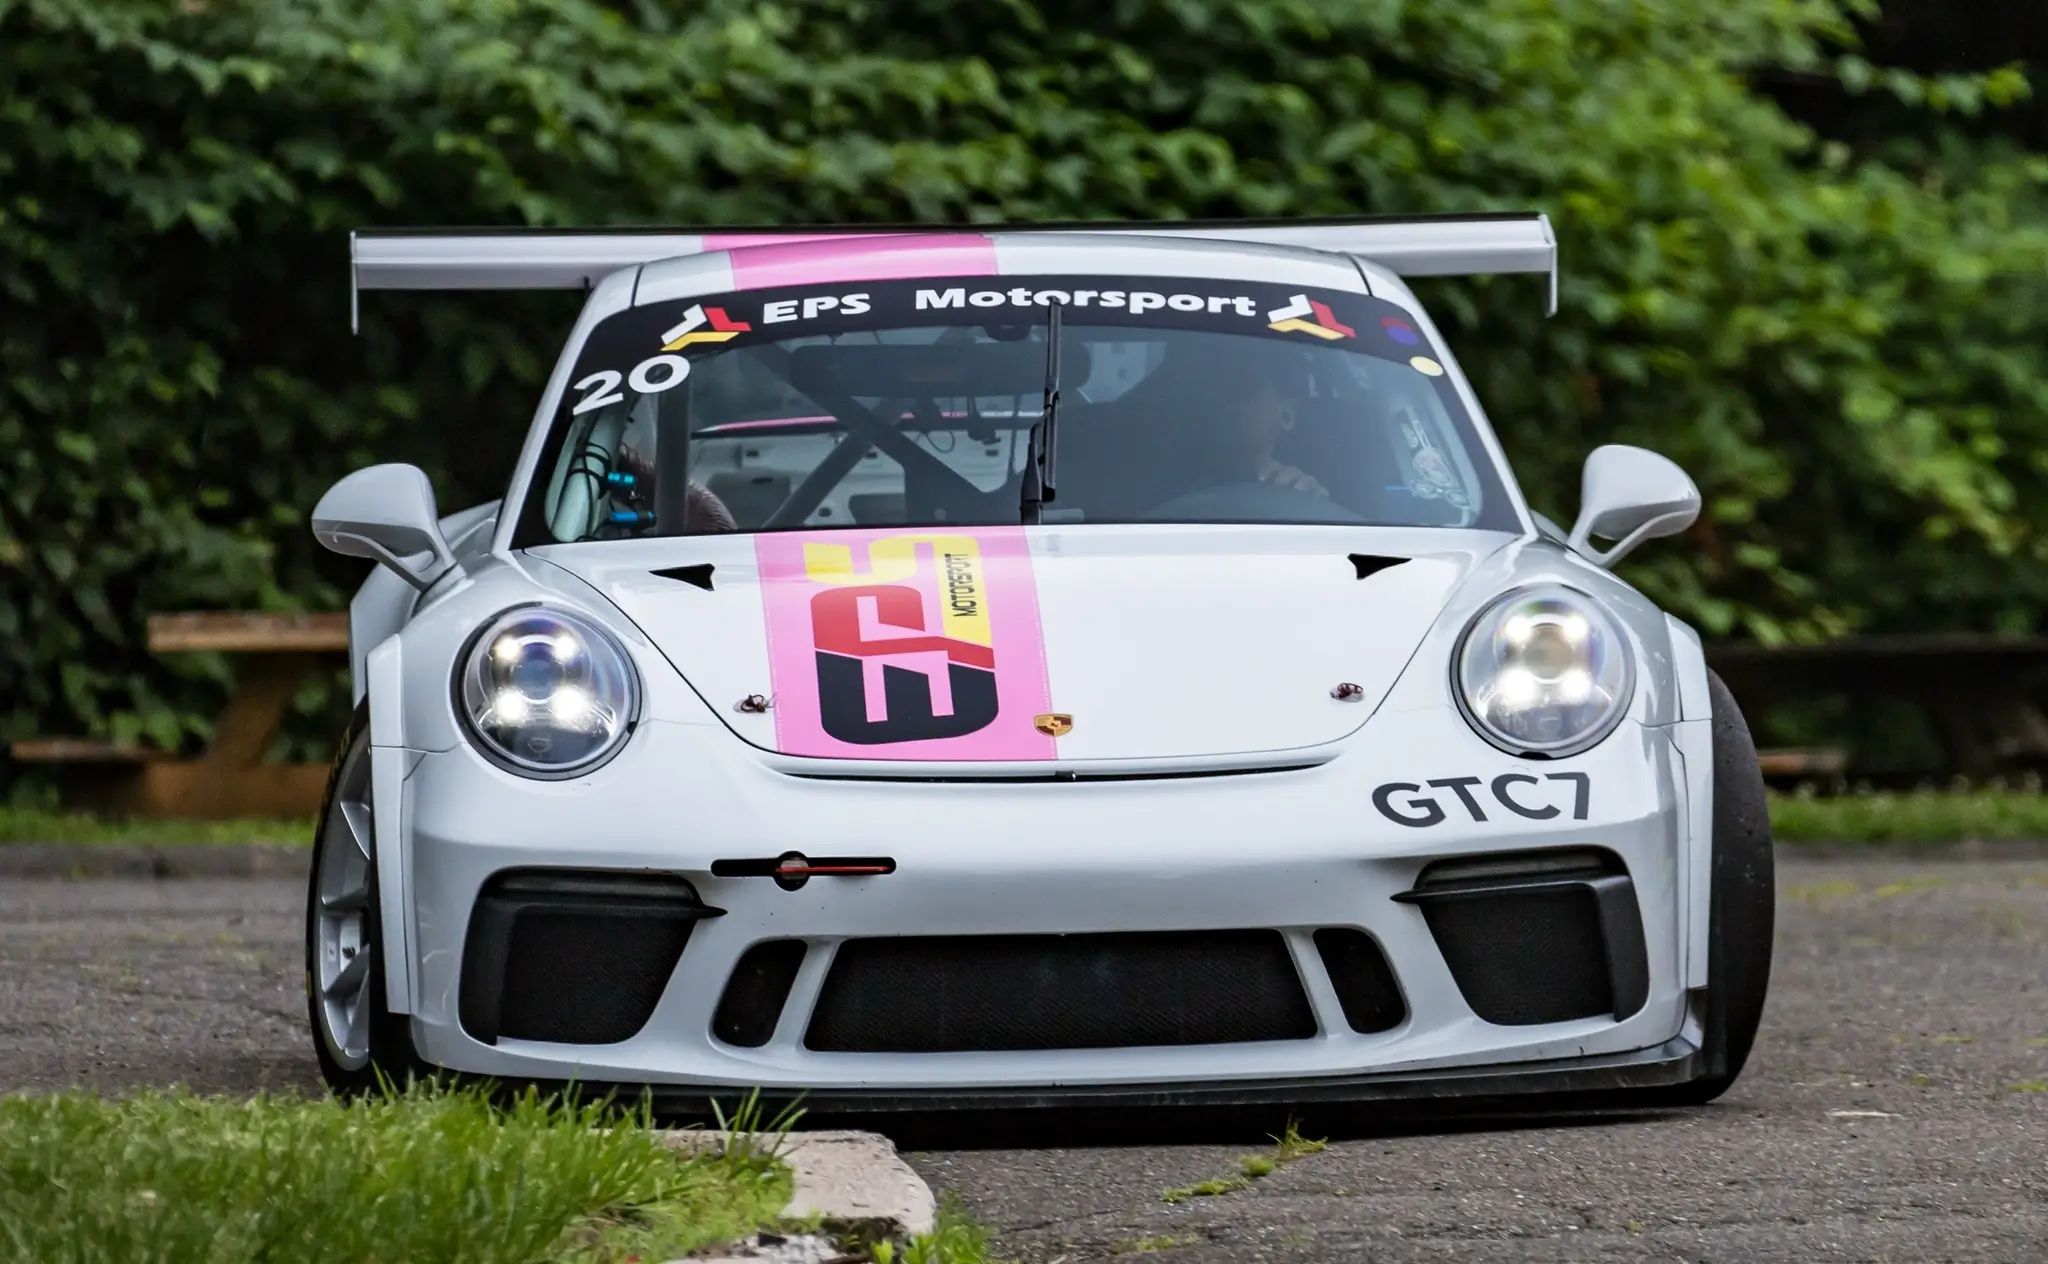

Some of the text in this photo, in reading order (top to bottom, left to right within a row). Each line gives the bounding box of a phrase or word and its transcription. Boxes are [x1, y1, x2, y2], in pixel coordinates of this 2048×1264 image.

[762, 287, 1257, 324] EPS Motorsport
[572, 354, 691, 416] 20
[943, 553, 978, 617] MOTORSPORT
[1371, 771, 1590, 828] GTC7
